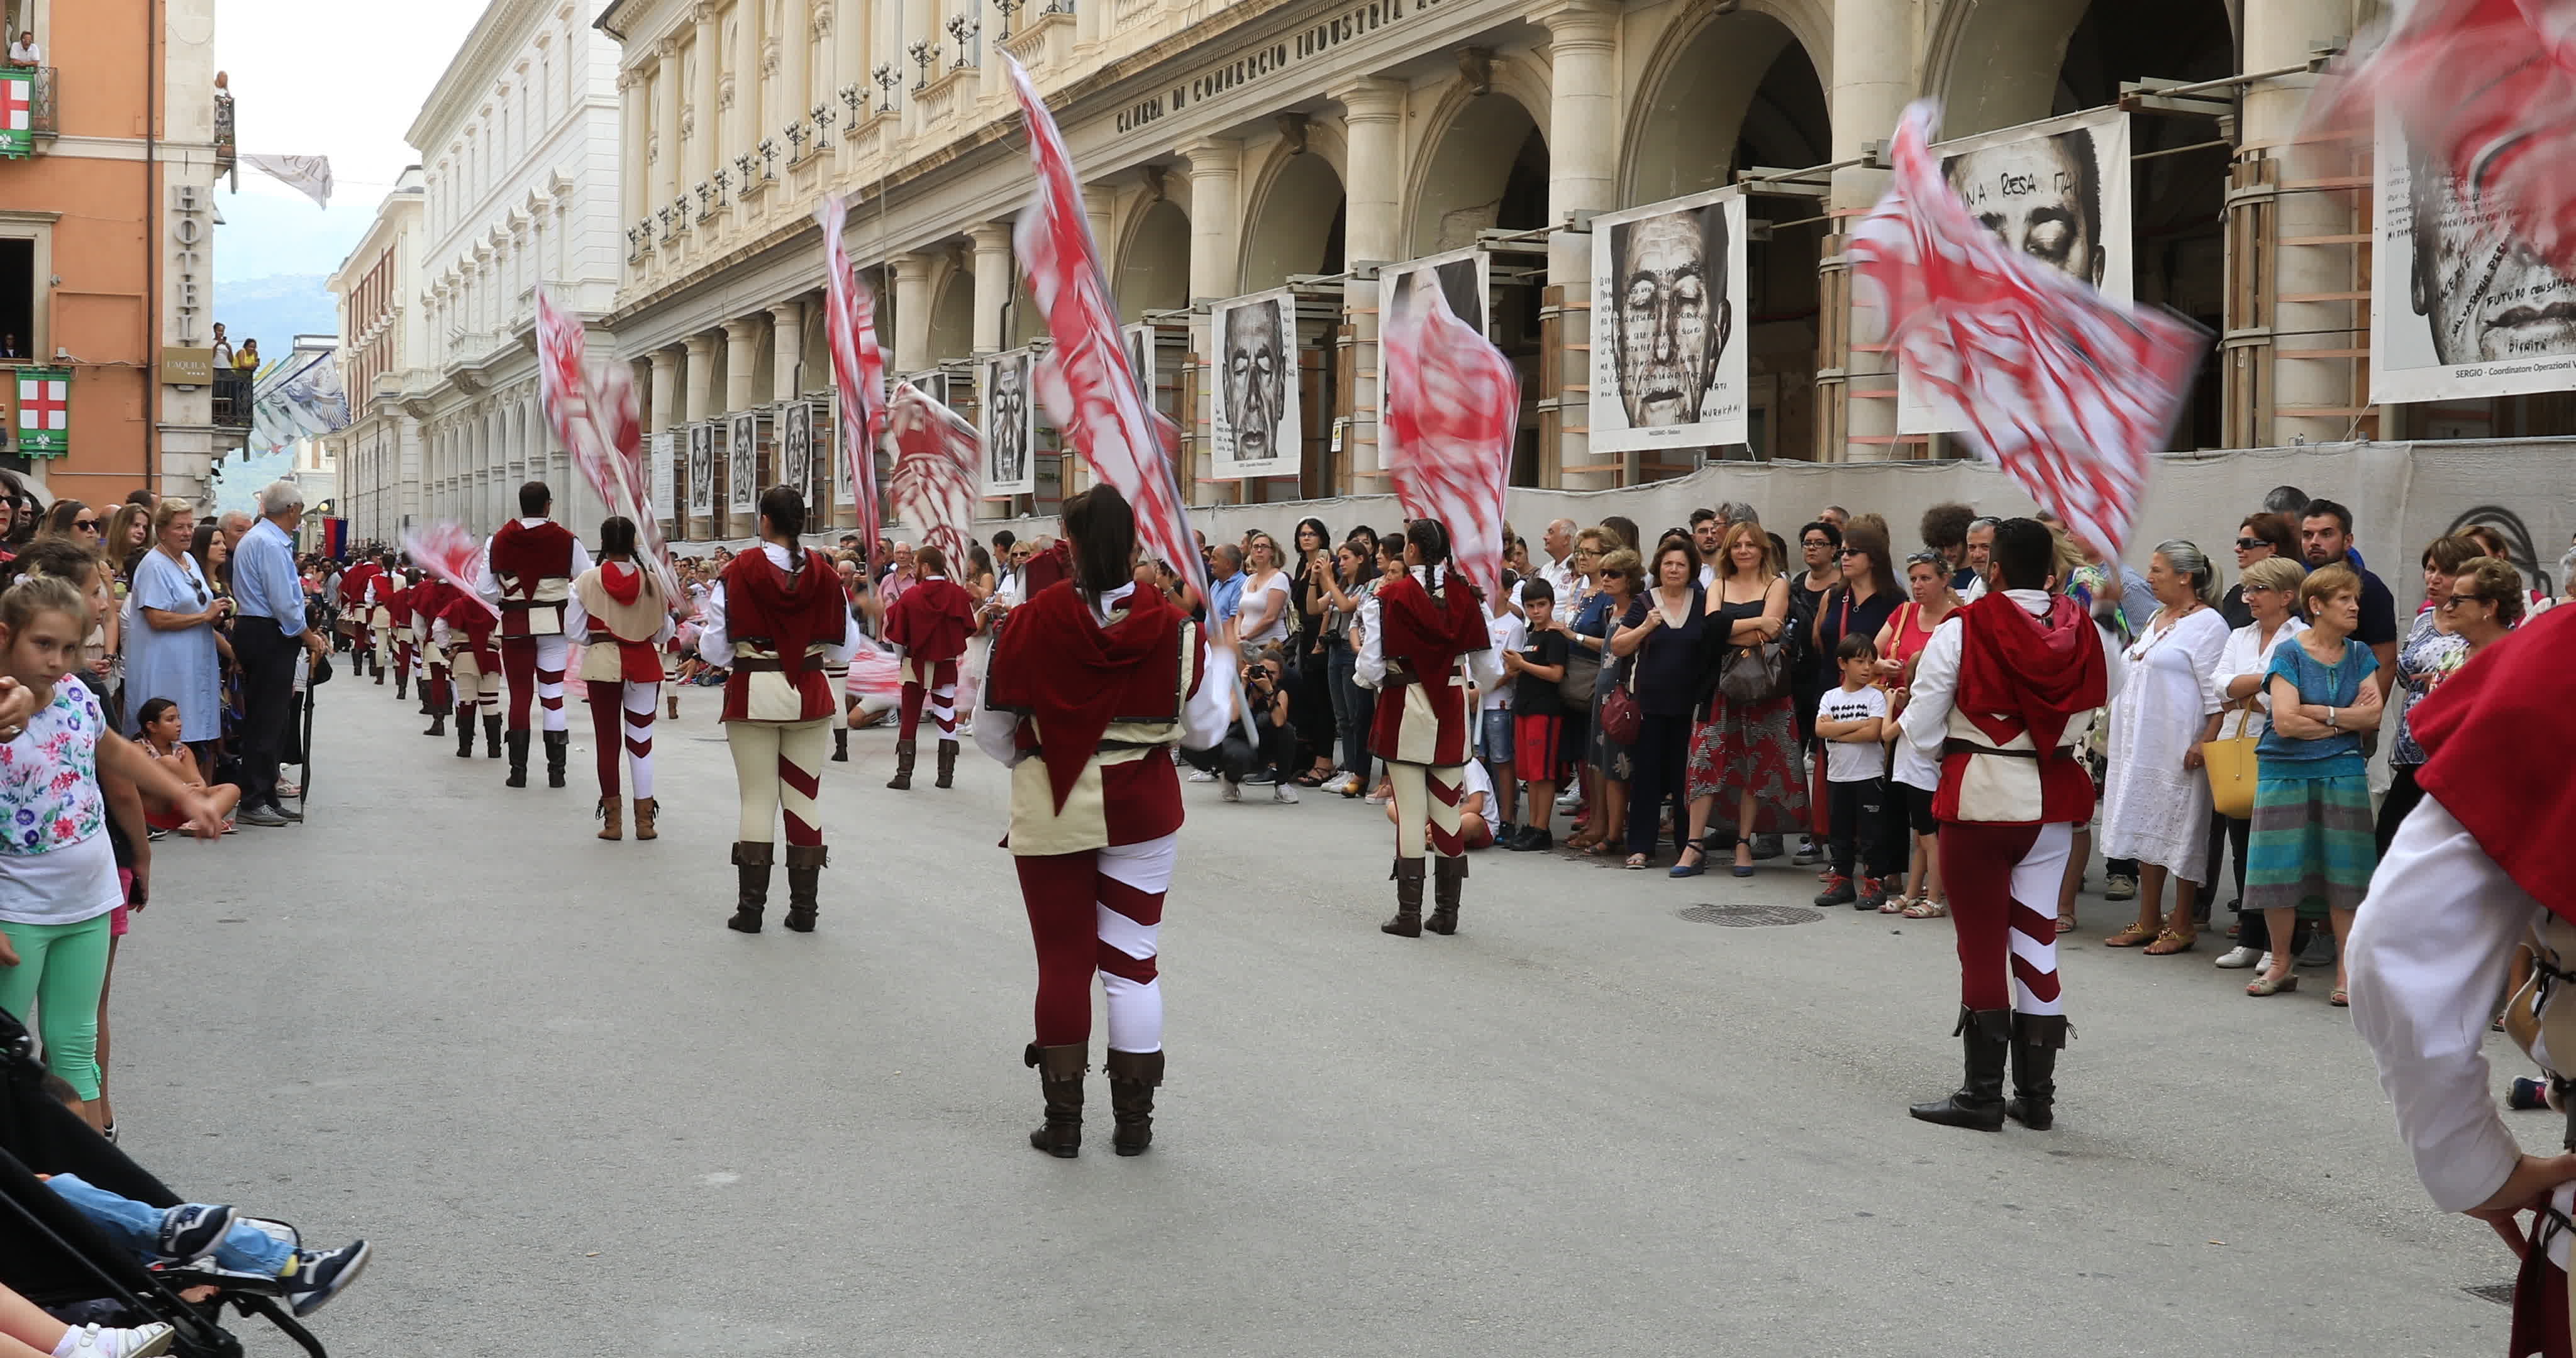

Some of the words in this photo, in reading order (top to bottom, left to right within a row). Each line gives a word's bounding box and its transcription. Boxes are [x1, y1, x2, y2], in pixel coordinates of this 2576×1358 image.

[1117, 95, 1163, 133] CAMERA
[1173, 86, 1185, 111] DI
[1193, 43, 1286, 102] COMMERCIO
[1297, 0, 1402, 60] INDUSTRIA
[170, 185, 205, 343] HOTEL
[2455, 369, 2483, 378] SERGIO
[2489, 365, 2532, 376] Coordinatore
[2533, 361, 2571, 372] Operazioni
[1702, 404, 1741, 418] MURAKAMI
